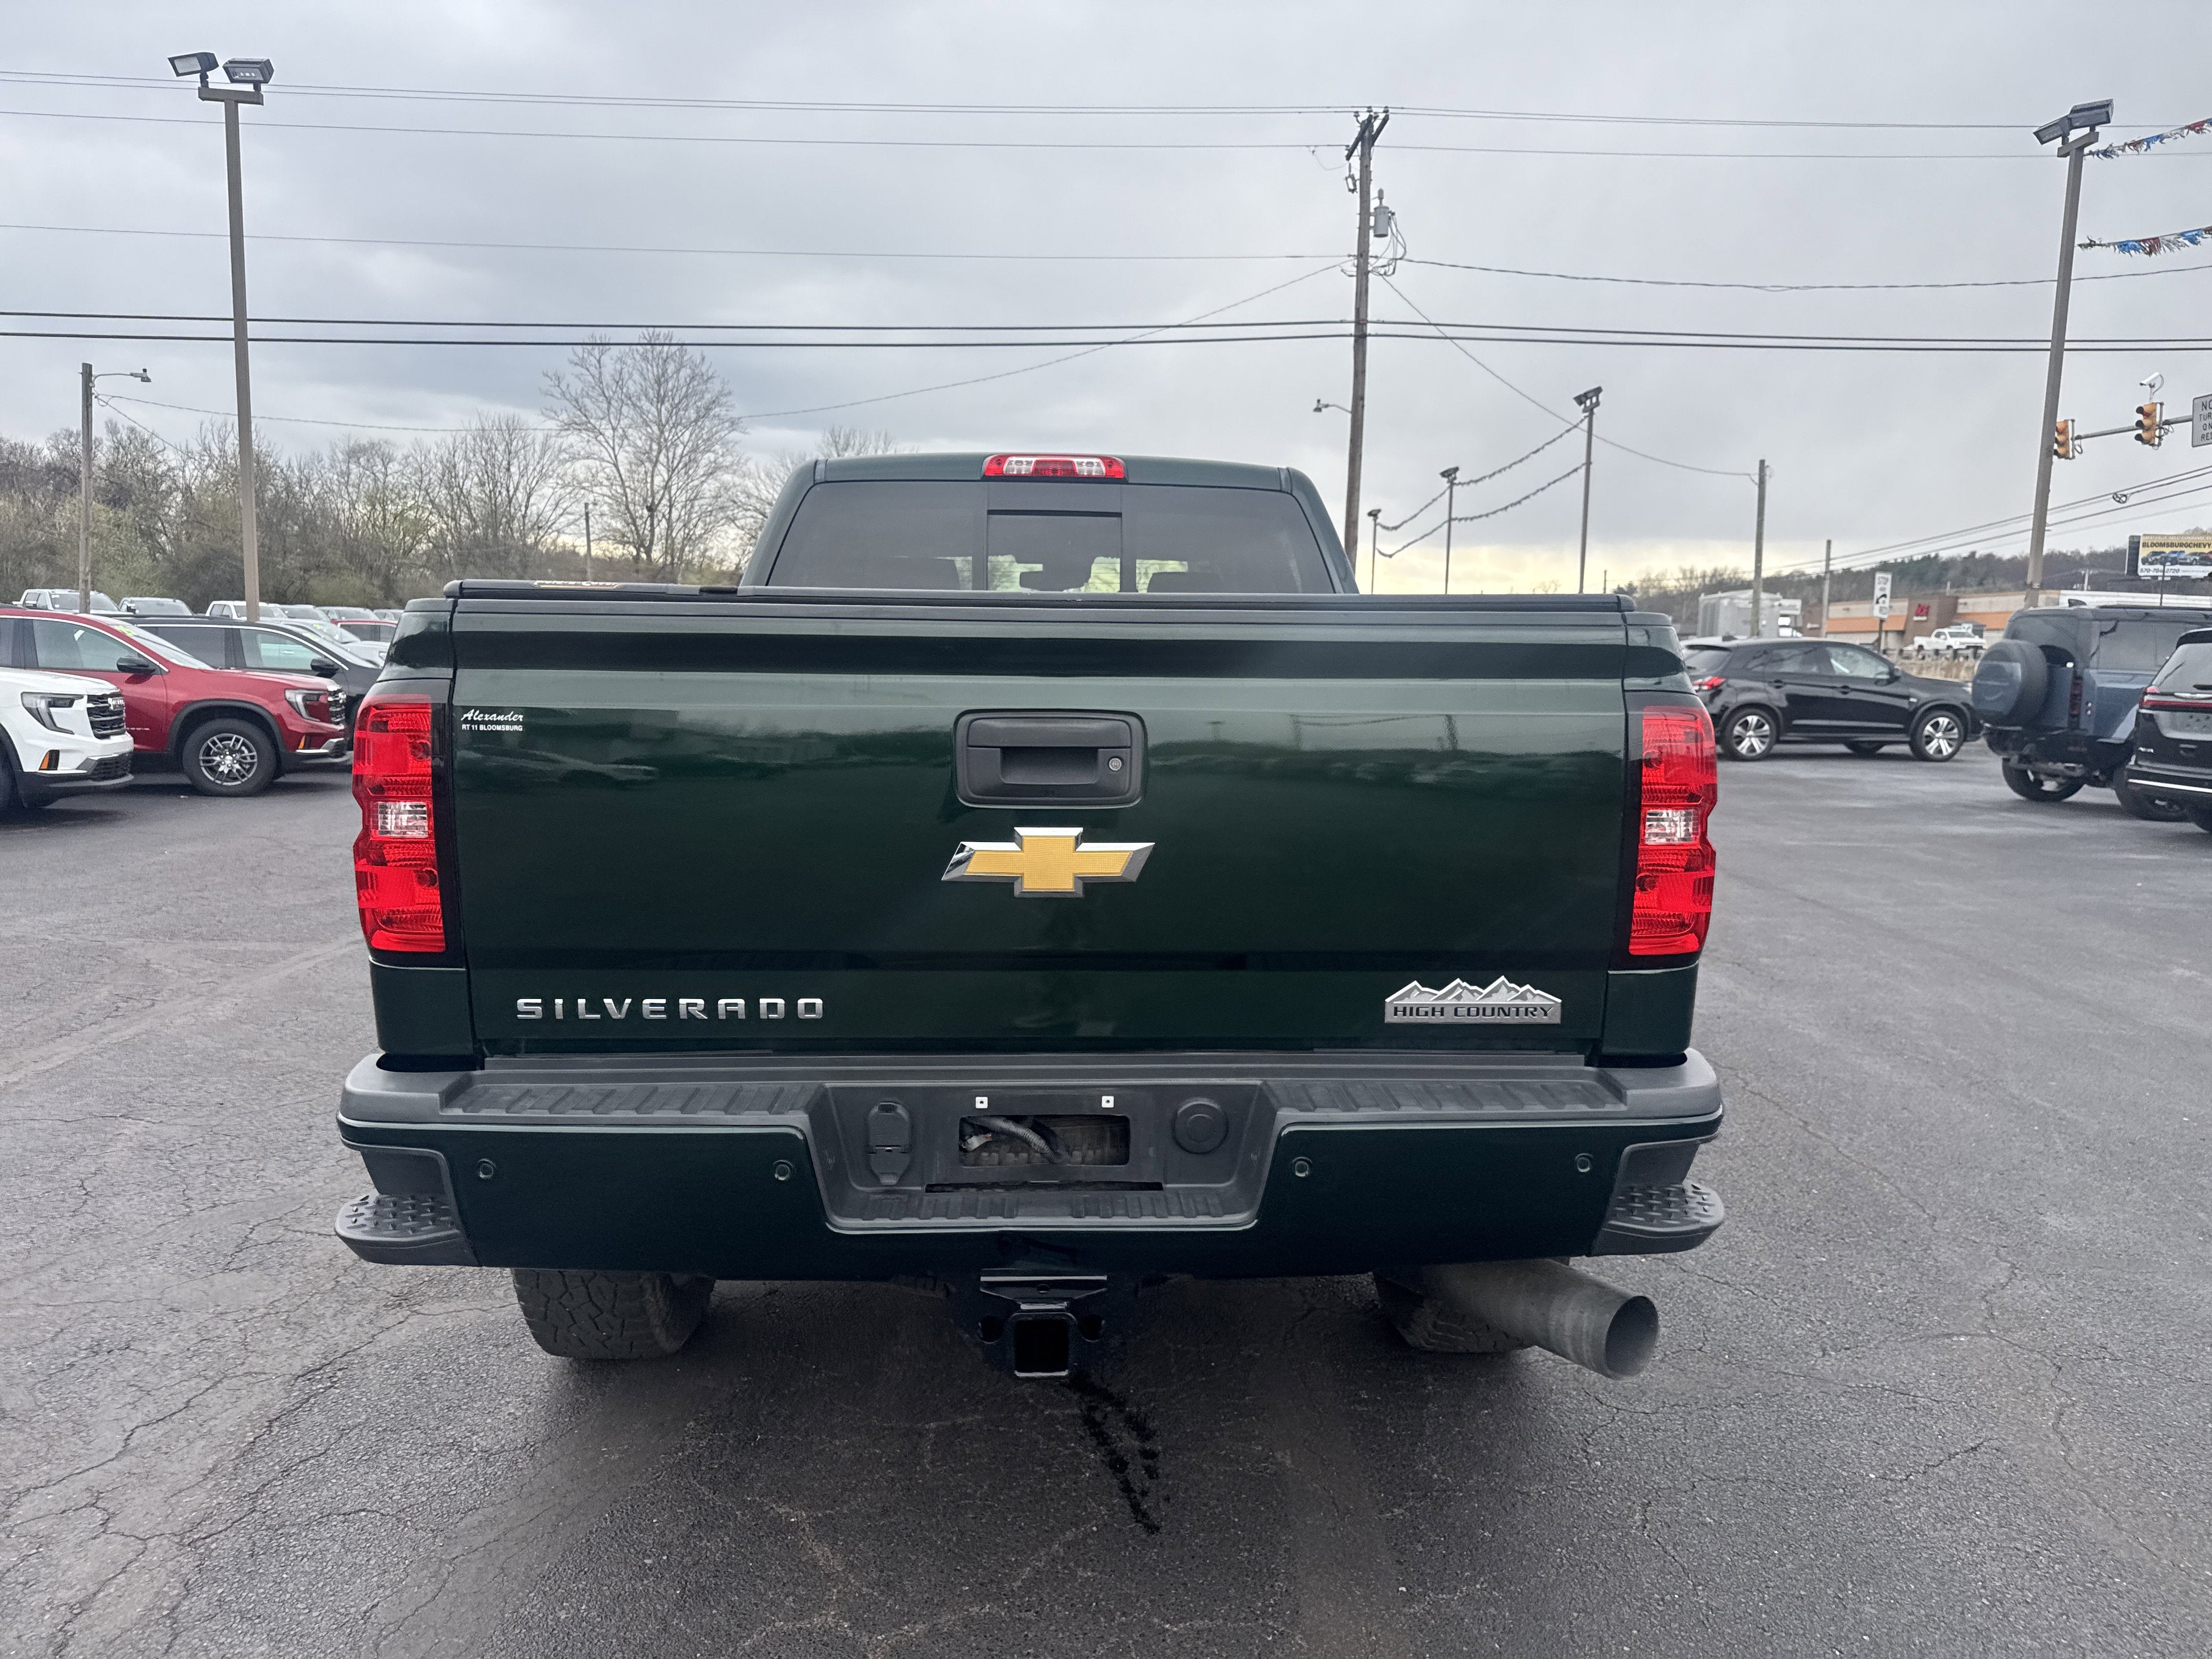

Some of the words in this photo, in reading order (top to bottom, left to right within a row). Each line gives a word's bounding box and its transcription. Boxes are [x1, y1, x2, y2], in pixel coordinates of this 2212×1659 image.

[2199, 412, 2212, 421] TUR
[461, 709, 523, 721] Alexander
[516, 998, 823, 1019] SILVERADO
[1393, 1007, 1445, 1017] HIGH
[1454, 1007, 1554, 1018] COUNTRY
